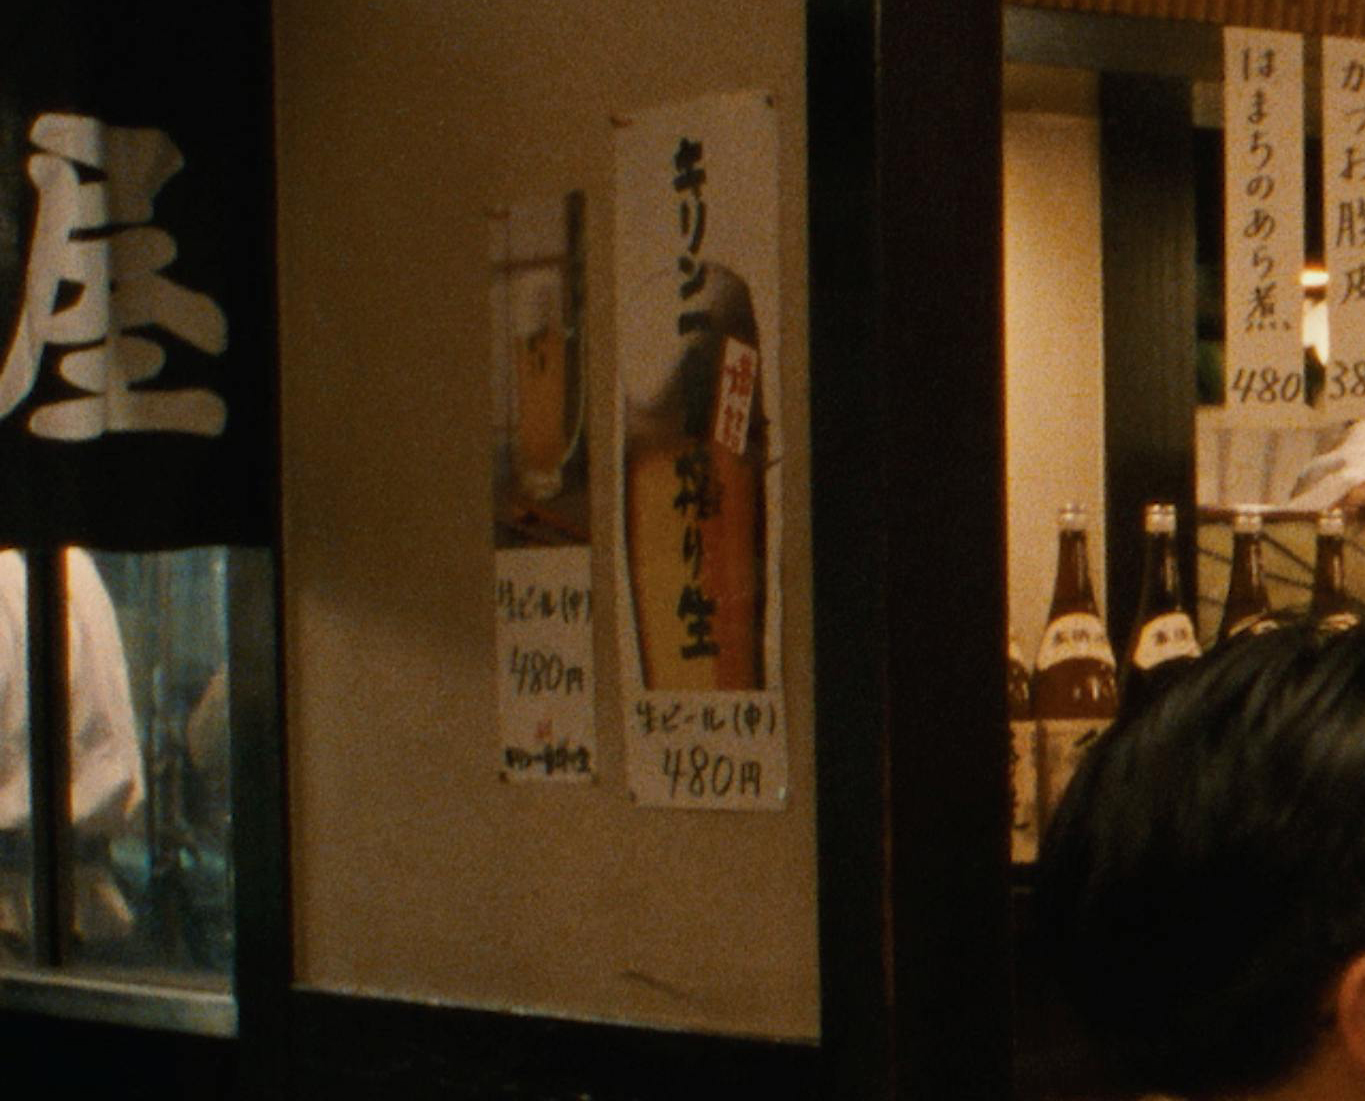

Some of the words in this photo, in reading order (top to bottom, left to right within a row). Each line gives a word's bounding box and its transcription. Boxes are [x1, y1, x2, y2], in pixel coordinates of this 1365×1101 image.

[0, 110, 229, 443] 屋
[1231, 368, 1303, 403] 480
[660, 743, 763, 799] 480円
